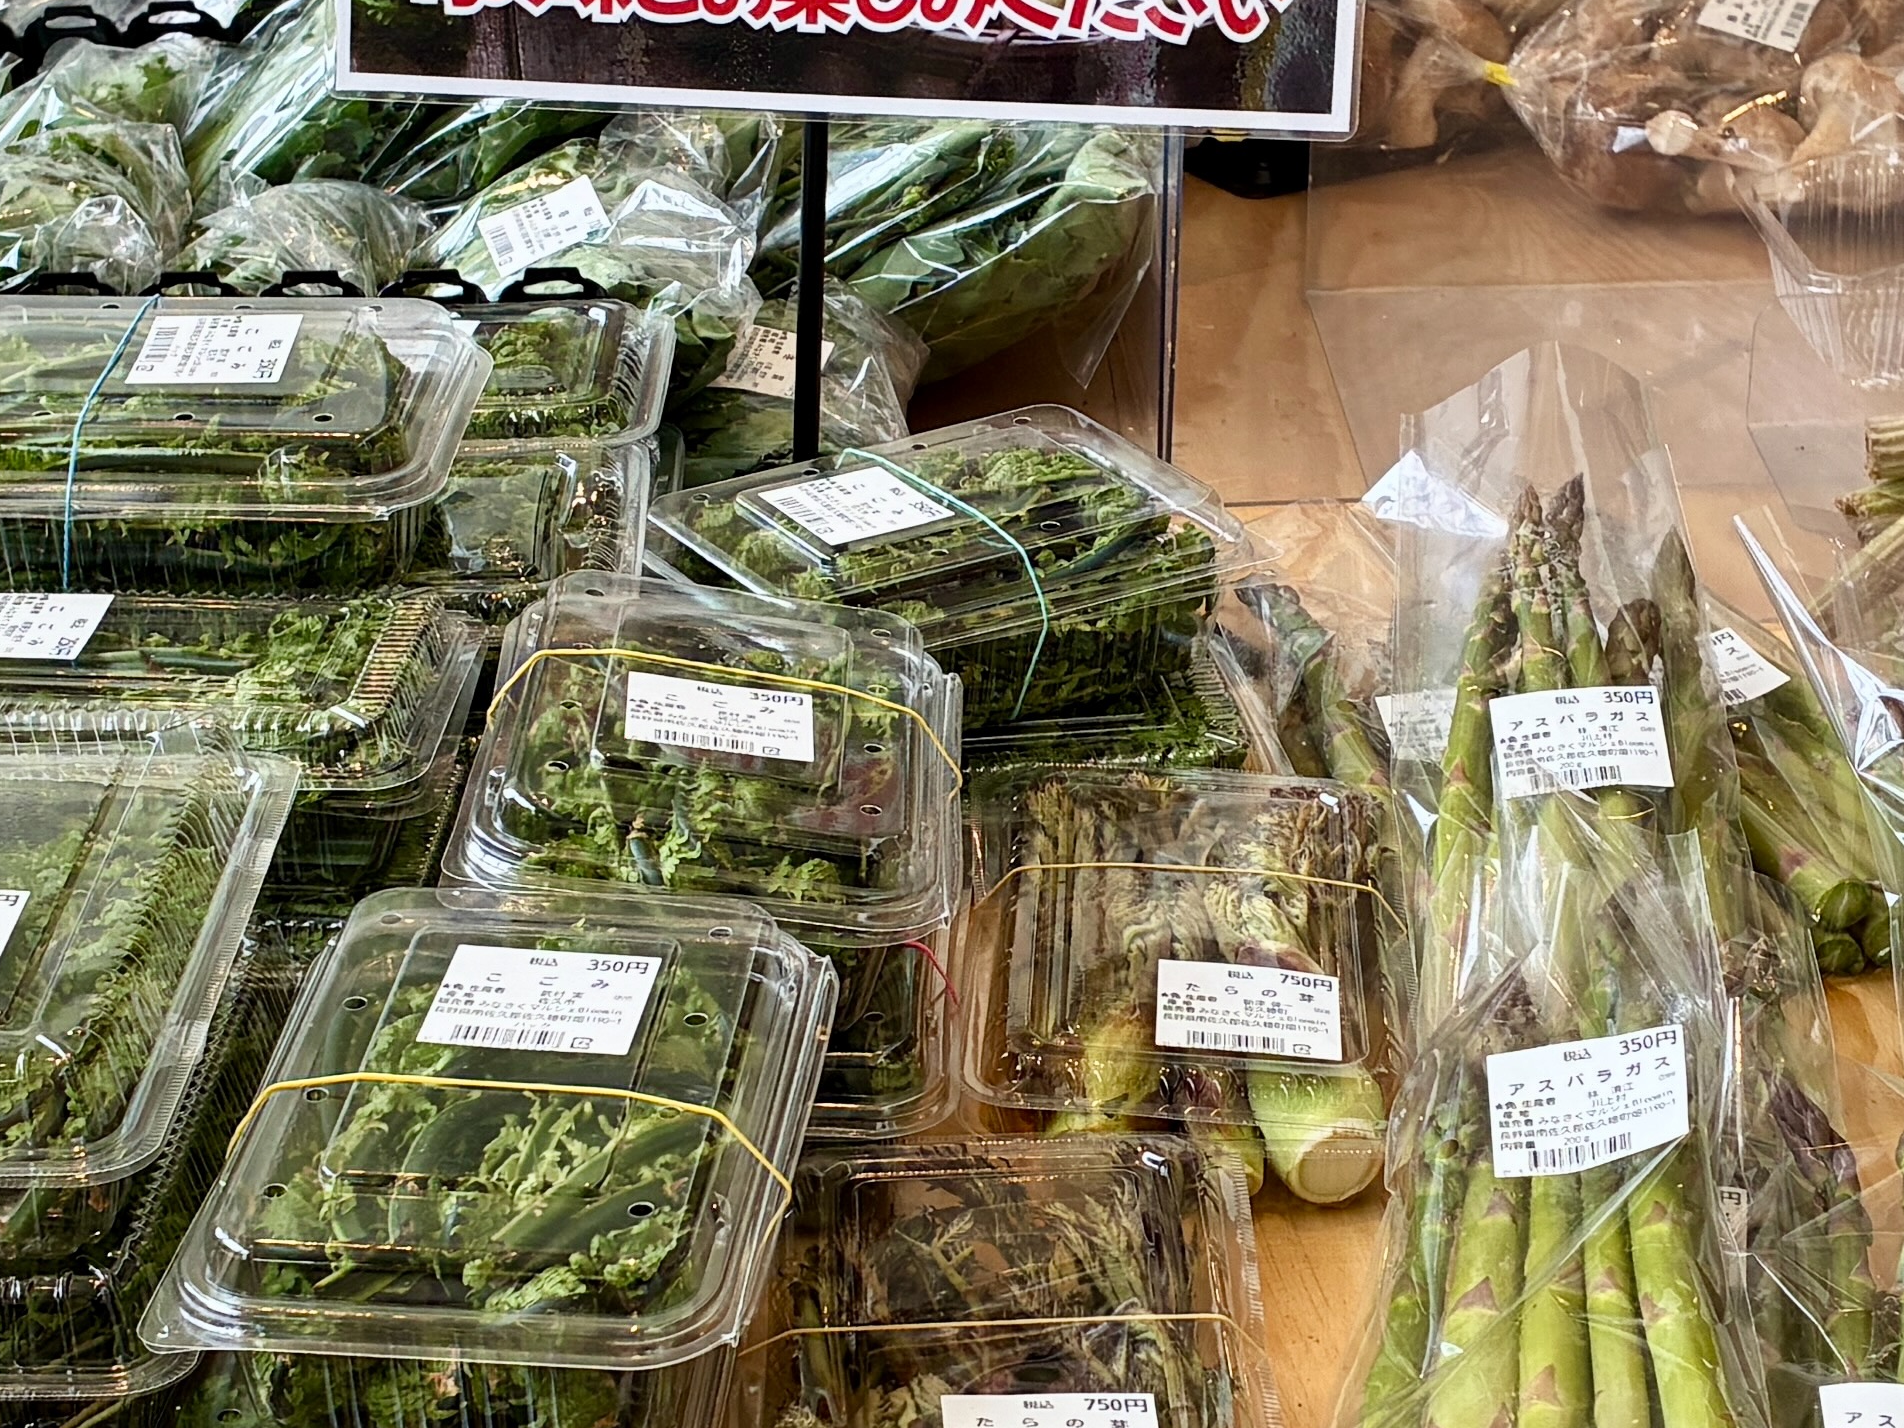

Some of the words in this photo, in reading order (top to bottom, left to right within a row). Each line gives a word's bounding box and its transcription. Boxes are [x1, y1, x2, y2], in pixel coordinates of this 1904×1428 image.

[749, 692, 804, 705] 350円
[1603, 691, 1654, 704] 350円
[586, 959, 649, 974] 350円
[1280, 973, 1332, 992] 750円
[1186, 983, 1314, 1004] たらの芽
[1564, 1048, 1592, 1061] 税込
[1619, 1030, 1677, 1055] 350円
[1084, 1398, 1147, 1413] 750円
